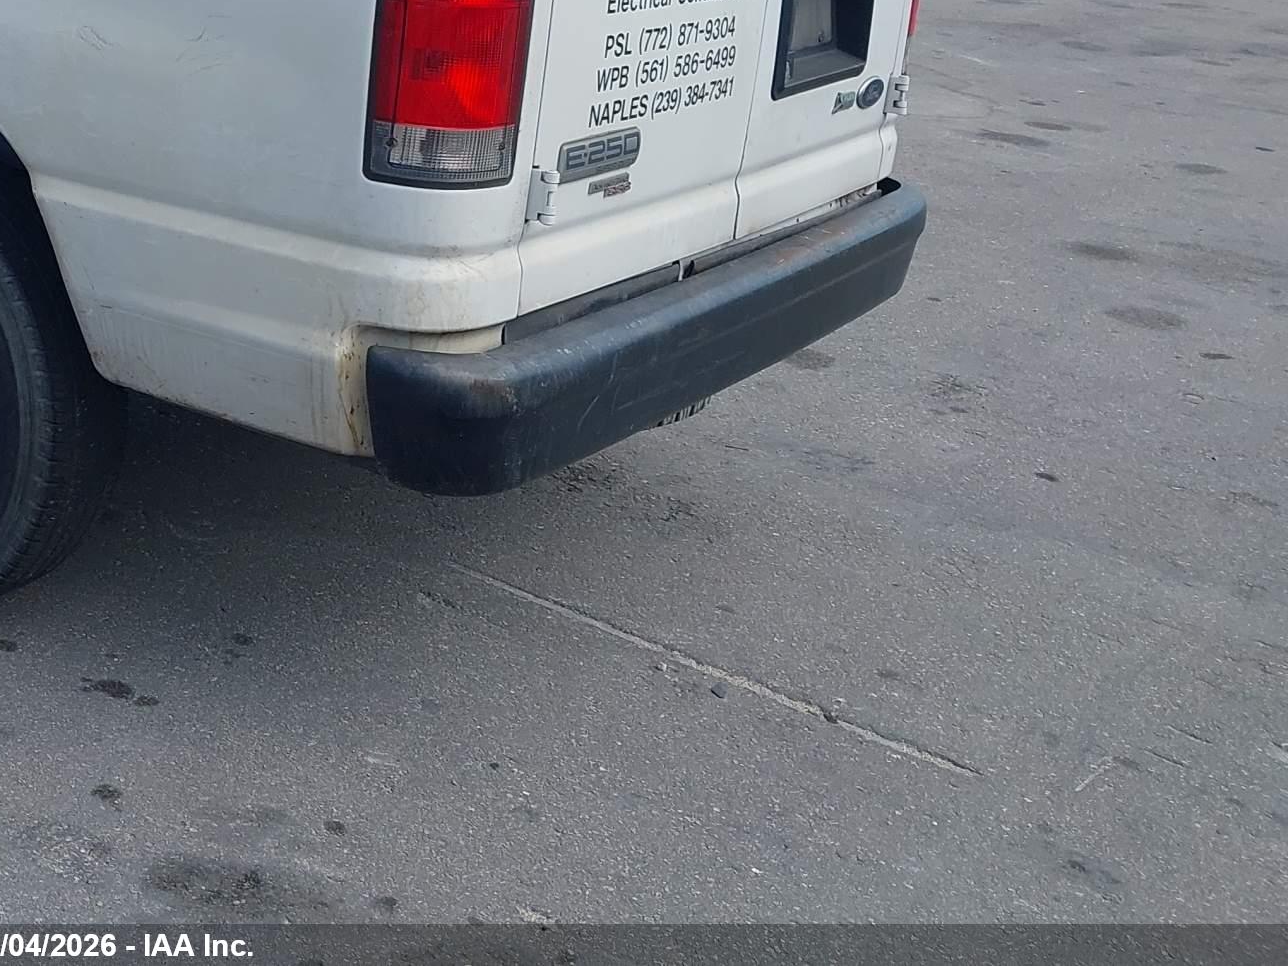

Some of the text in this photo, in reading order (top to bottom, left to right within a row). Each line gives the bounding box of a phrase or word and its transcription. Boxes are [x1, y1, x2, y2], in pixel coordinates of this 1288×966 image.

[604, 16, 736, 58] PSL (772) 871-9304
[597, 46, 736, 92] WPB (561) 586-6499
[588, 77, 734, 128] NAPLES (239) 384-7341
